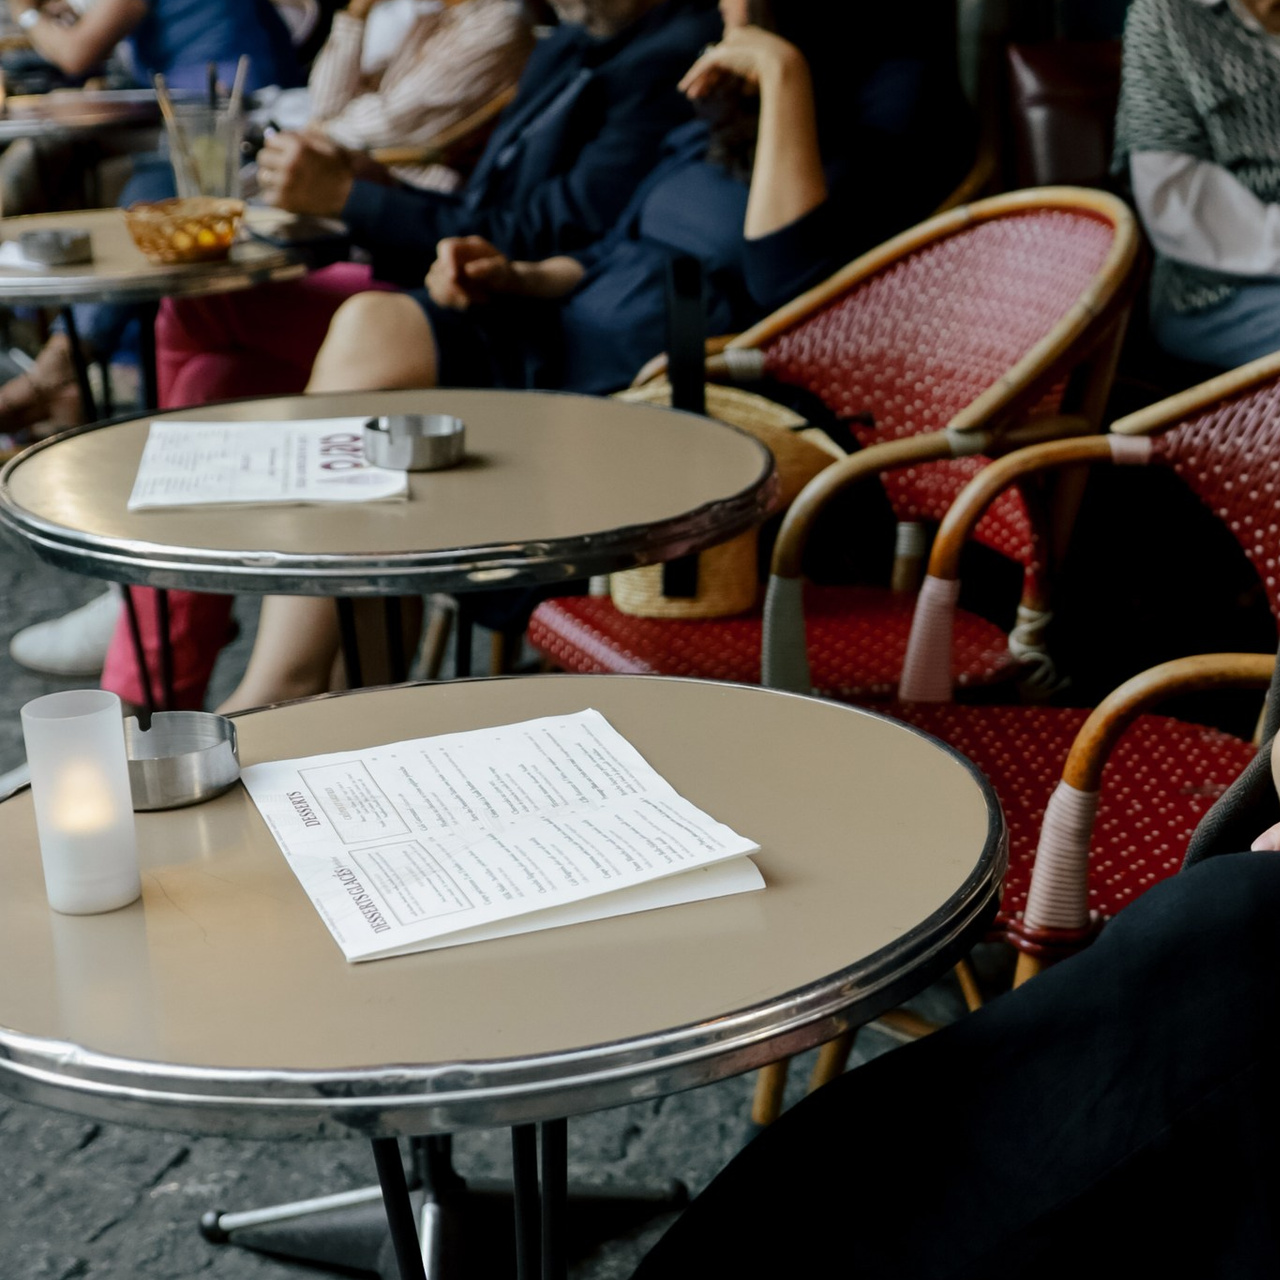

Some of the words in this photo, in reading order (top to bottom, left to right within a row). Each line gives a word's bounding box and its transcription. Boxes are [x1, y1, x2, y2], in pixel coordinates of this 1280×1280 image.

[285, 790, 321, 827] DESSERTS
[331, 867, 366, 896] GLACÉS
[351, 893, 391, 933] DESSERTS
